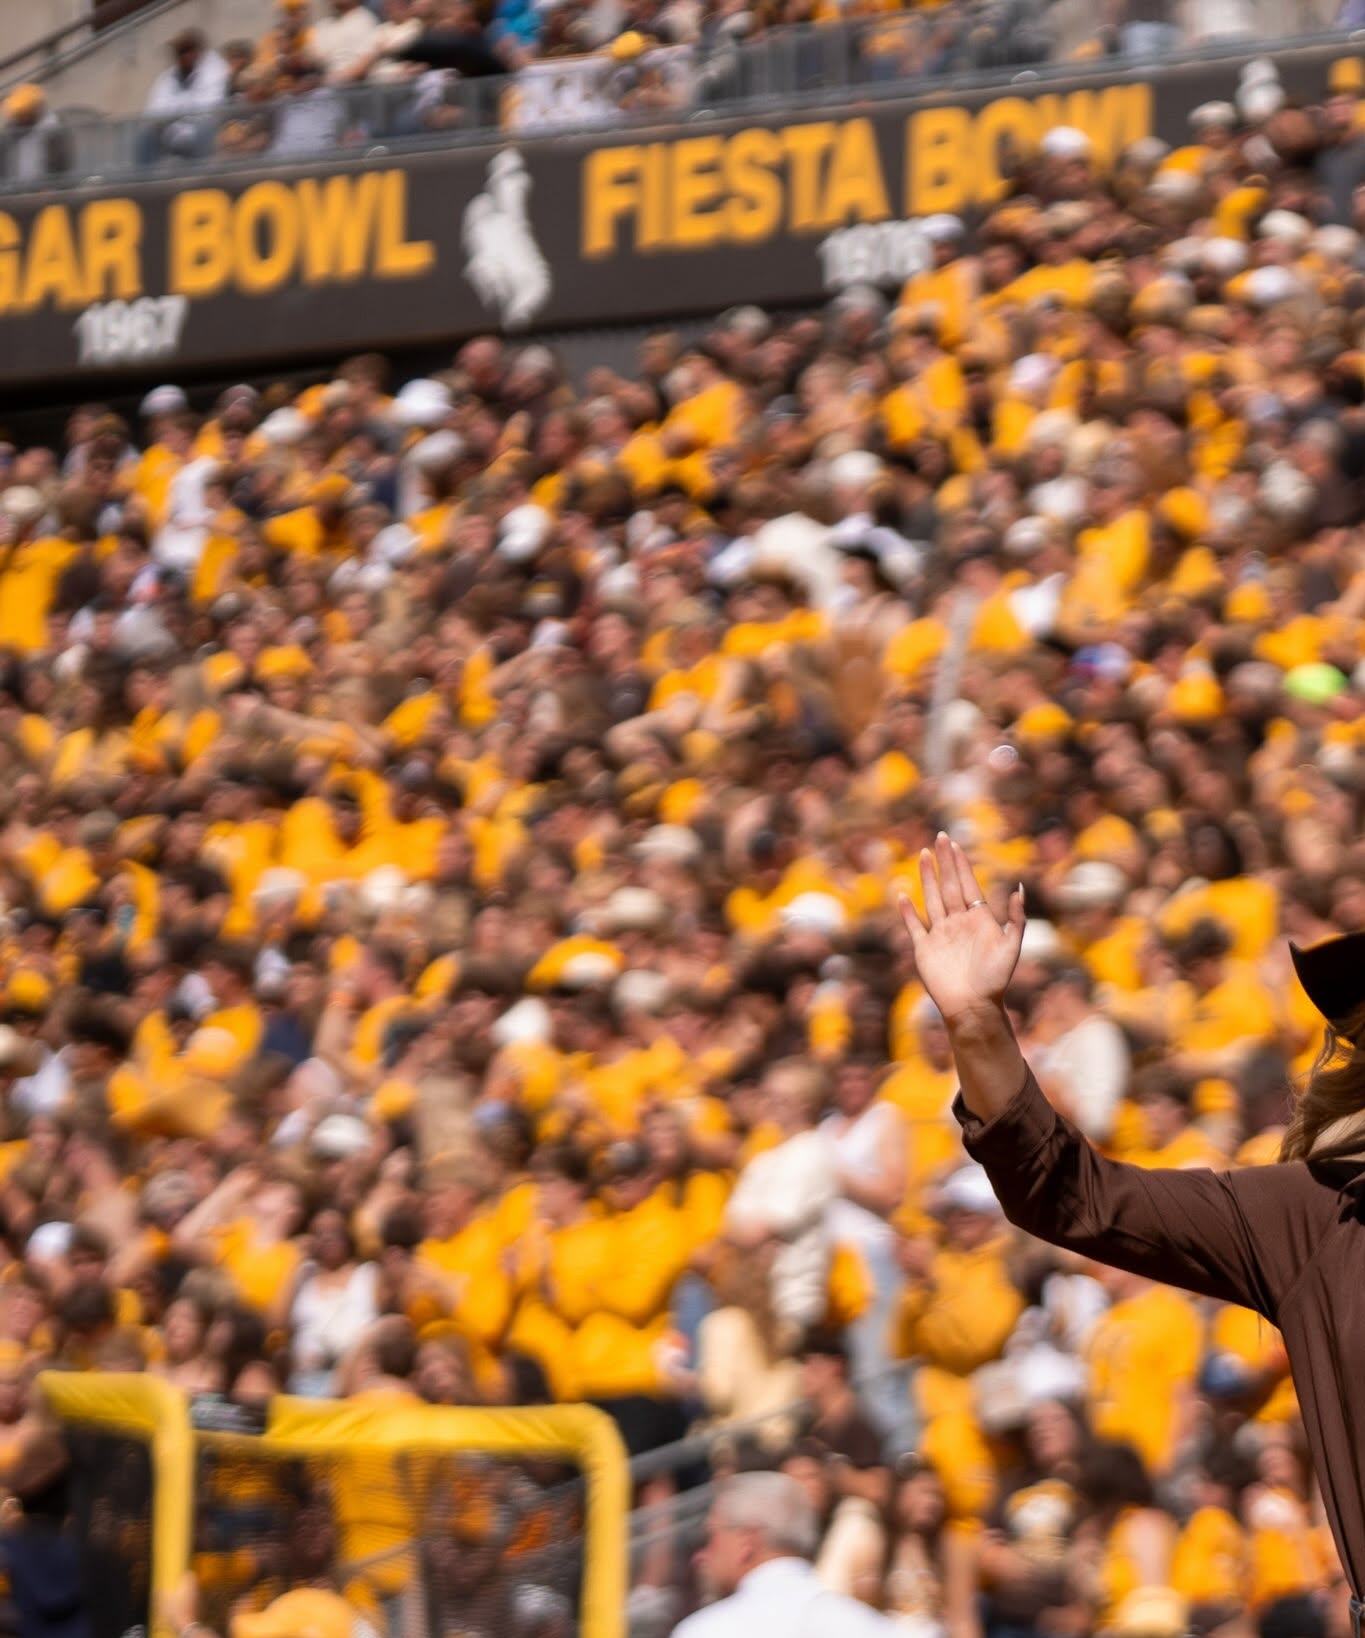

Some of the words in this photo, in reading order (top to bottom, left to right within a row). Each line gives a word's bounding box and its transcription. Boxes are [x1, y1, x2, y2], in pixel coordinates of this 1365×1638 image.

[166, 168, 438, 295] BOWL
[580, 116, 892, 259] FIESTA
[74, 294, 190, 367] 1967
